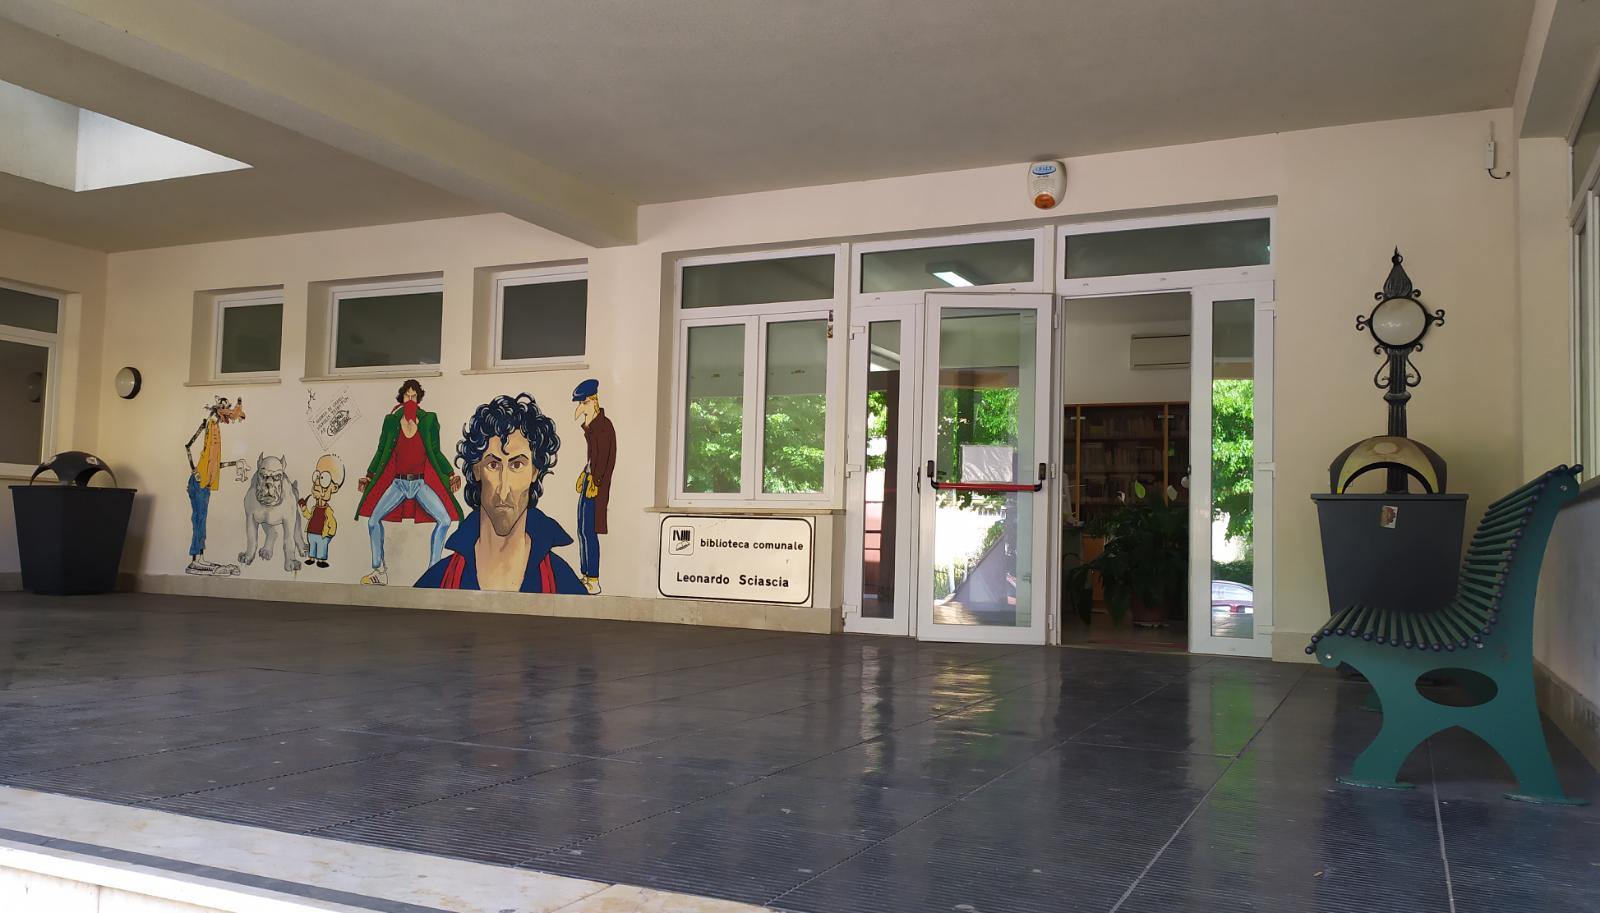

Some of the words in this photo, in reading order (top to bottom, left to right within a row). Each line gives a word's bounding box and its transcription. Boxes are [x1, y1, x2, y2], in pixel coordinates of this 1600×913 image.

[700, 537, 750, 549] biblioteca
[752, 541, 804, 551] comunale
[676, 571, 730, 585] Leonardo
[738, 574, 789, 588] Sciascia
